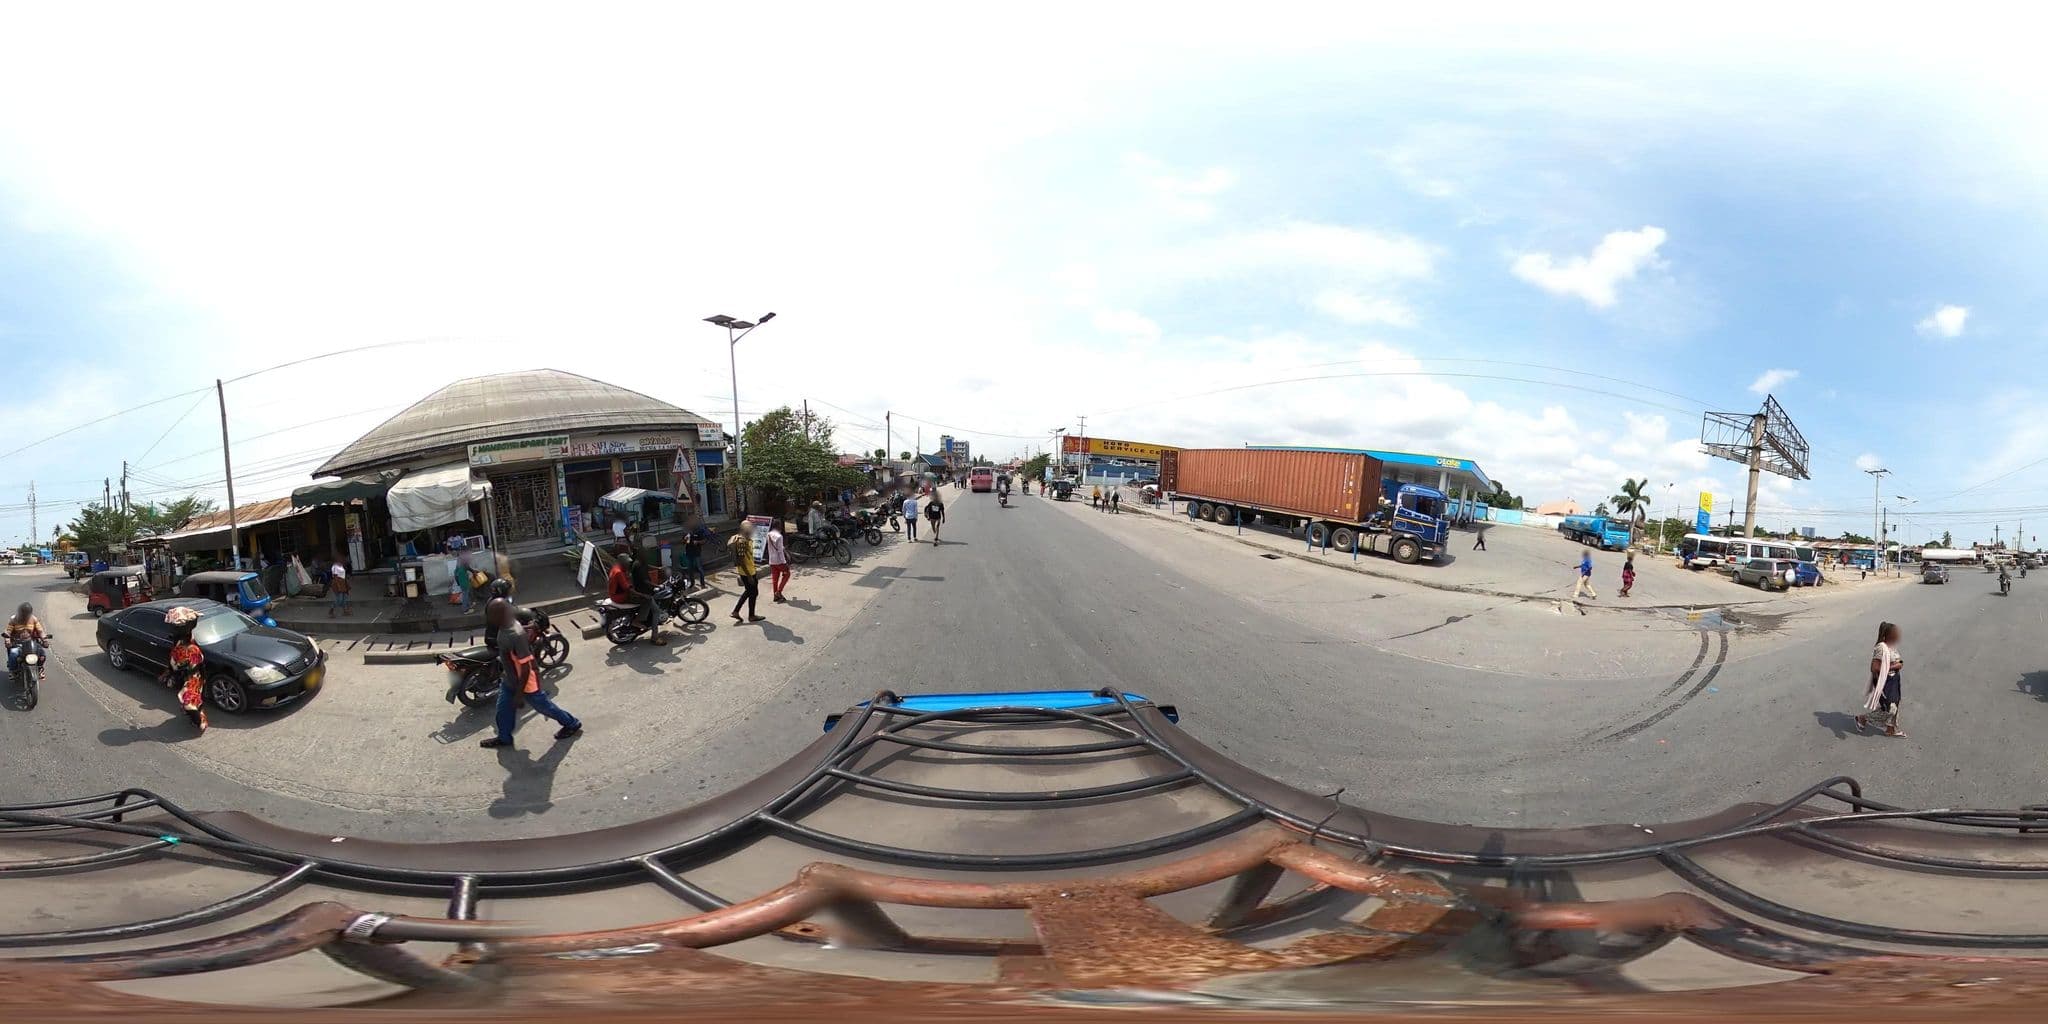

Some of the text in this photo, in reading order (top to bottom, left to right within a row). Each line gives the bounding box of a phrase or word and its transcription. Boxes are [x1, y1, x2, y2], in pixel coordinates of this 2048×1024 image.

[520, 438, 546, 448] SPARE
[547, 436, 568, 446] PART
[1103, 445, 1145, 454] SERVICE
